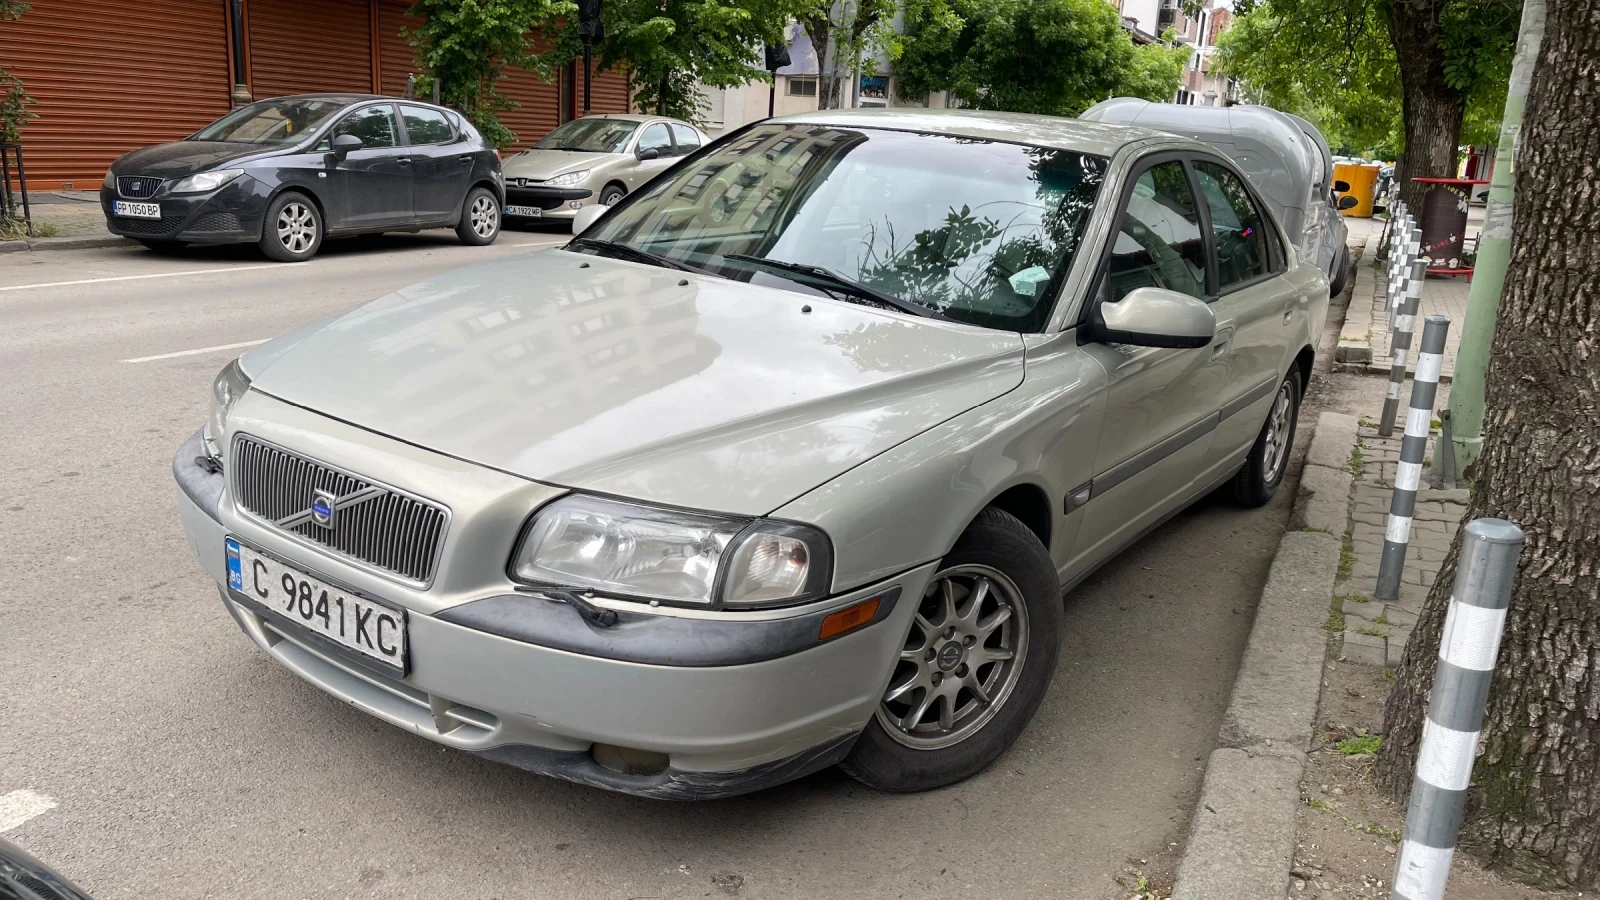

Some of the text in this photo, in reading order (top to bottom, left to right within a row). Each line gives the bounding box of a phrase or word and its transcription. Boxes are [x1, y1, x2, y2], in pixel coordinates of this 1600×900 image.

[117, 202, 126, 213] PP
[128, 203, 147, 215] 1050
[148, 205, 158, 216] BP
[509, 206, 517, 214] CA
[518, 207, 532, 216] 1922
[231, 571, 242, 585] BG
[253, 558, 398, 657] C 9841 KC
